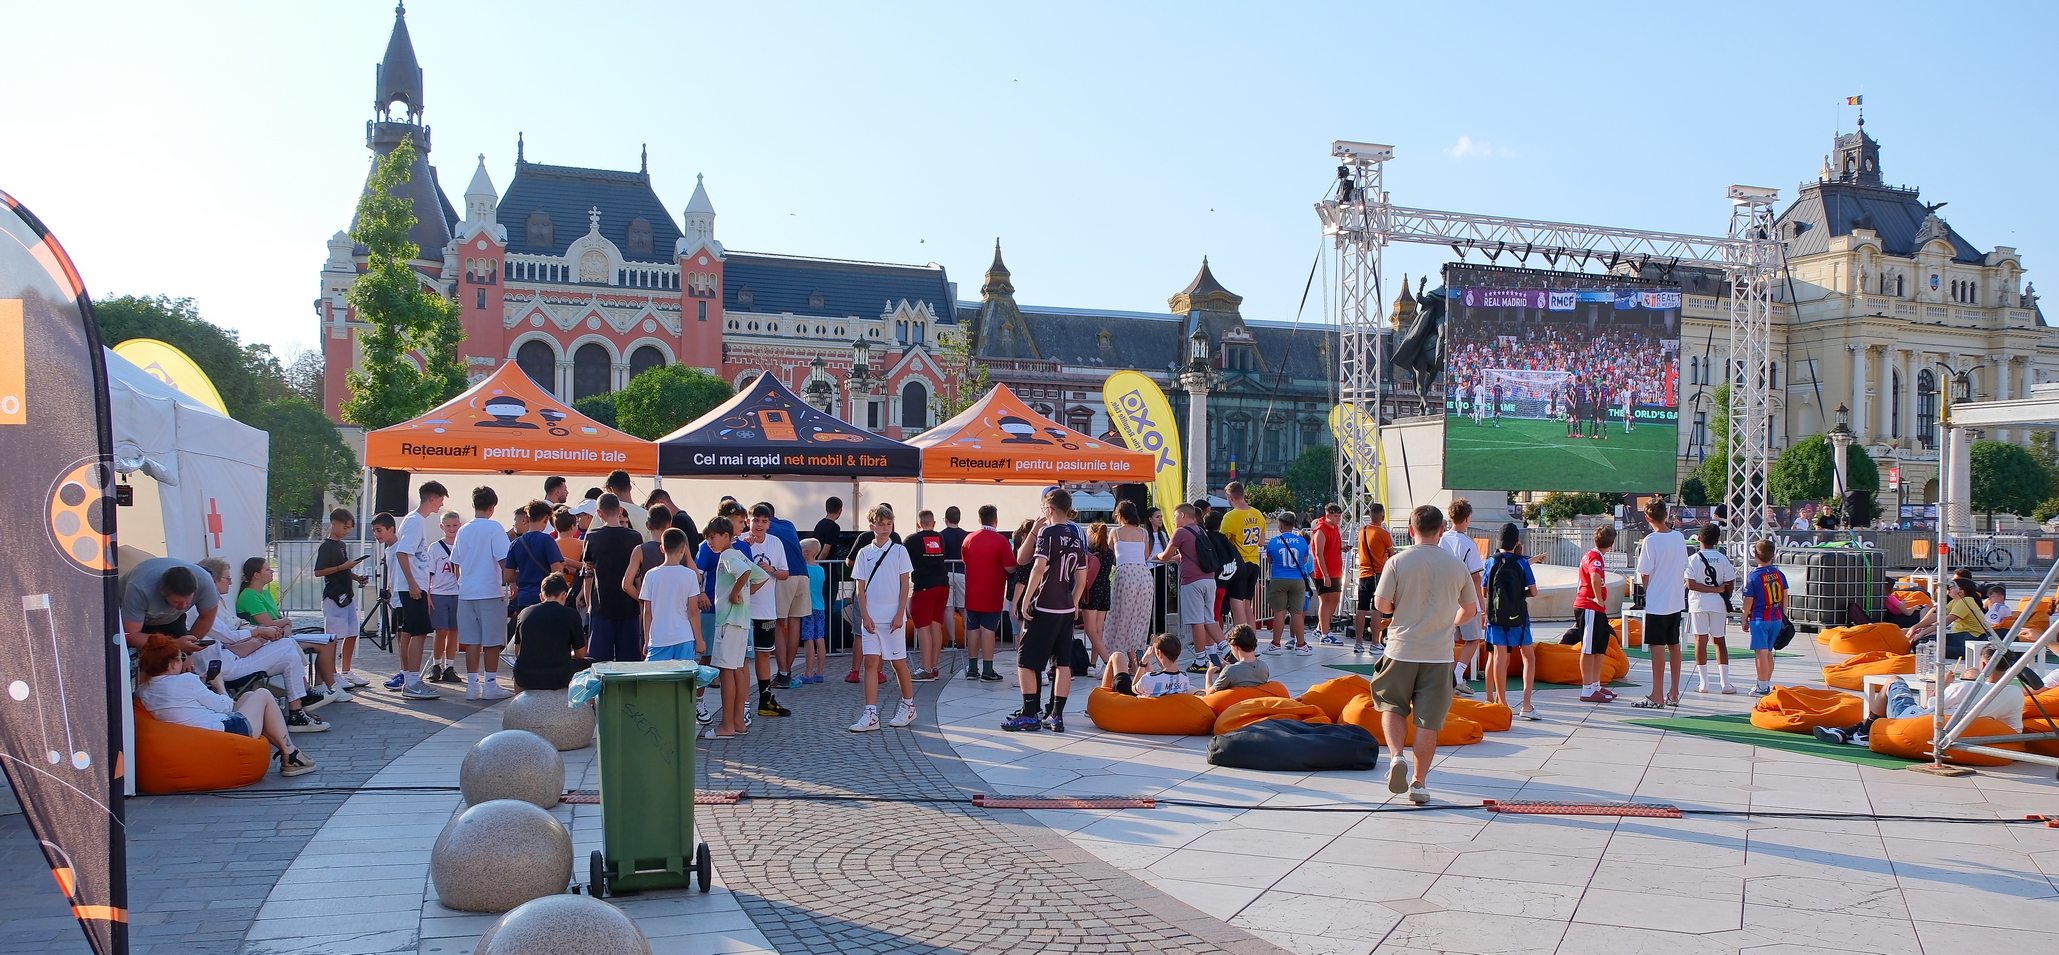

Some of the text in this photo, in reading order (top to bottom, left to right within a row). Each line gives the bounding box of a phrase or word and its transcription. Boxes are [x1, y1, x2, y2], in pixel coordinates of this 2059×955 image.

[1484, 297, 1527, 307] REAL MADRID
[1550, 296, 1575, 307] RMCF
[1656, 293, 1676, 302] REAL
[1634, 410, 1665, 419] ORLD'S
[401, 442, 627, 463] Rețeaua#1 pentru pasiunile tale
[693, 453, 888, 468] Cel mai rapid net mobil & fibră
[950, 456, 1130, 472] Rețeaua#1 pentru pasiunile tale
[1243, 526, 1261, 547] 23
[1279, 547, 1299, 569] 10
[1059, 550, 1078, 583] 10
[1763, 581, 1783, 605] 10
